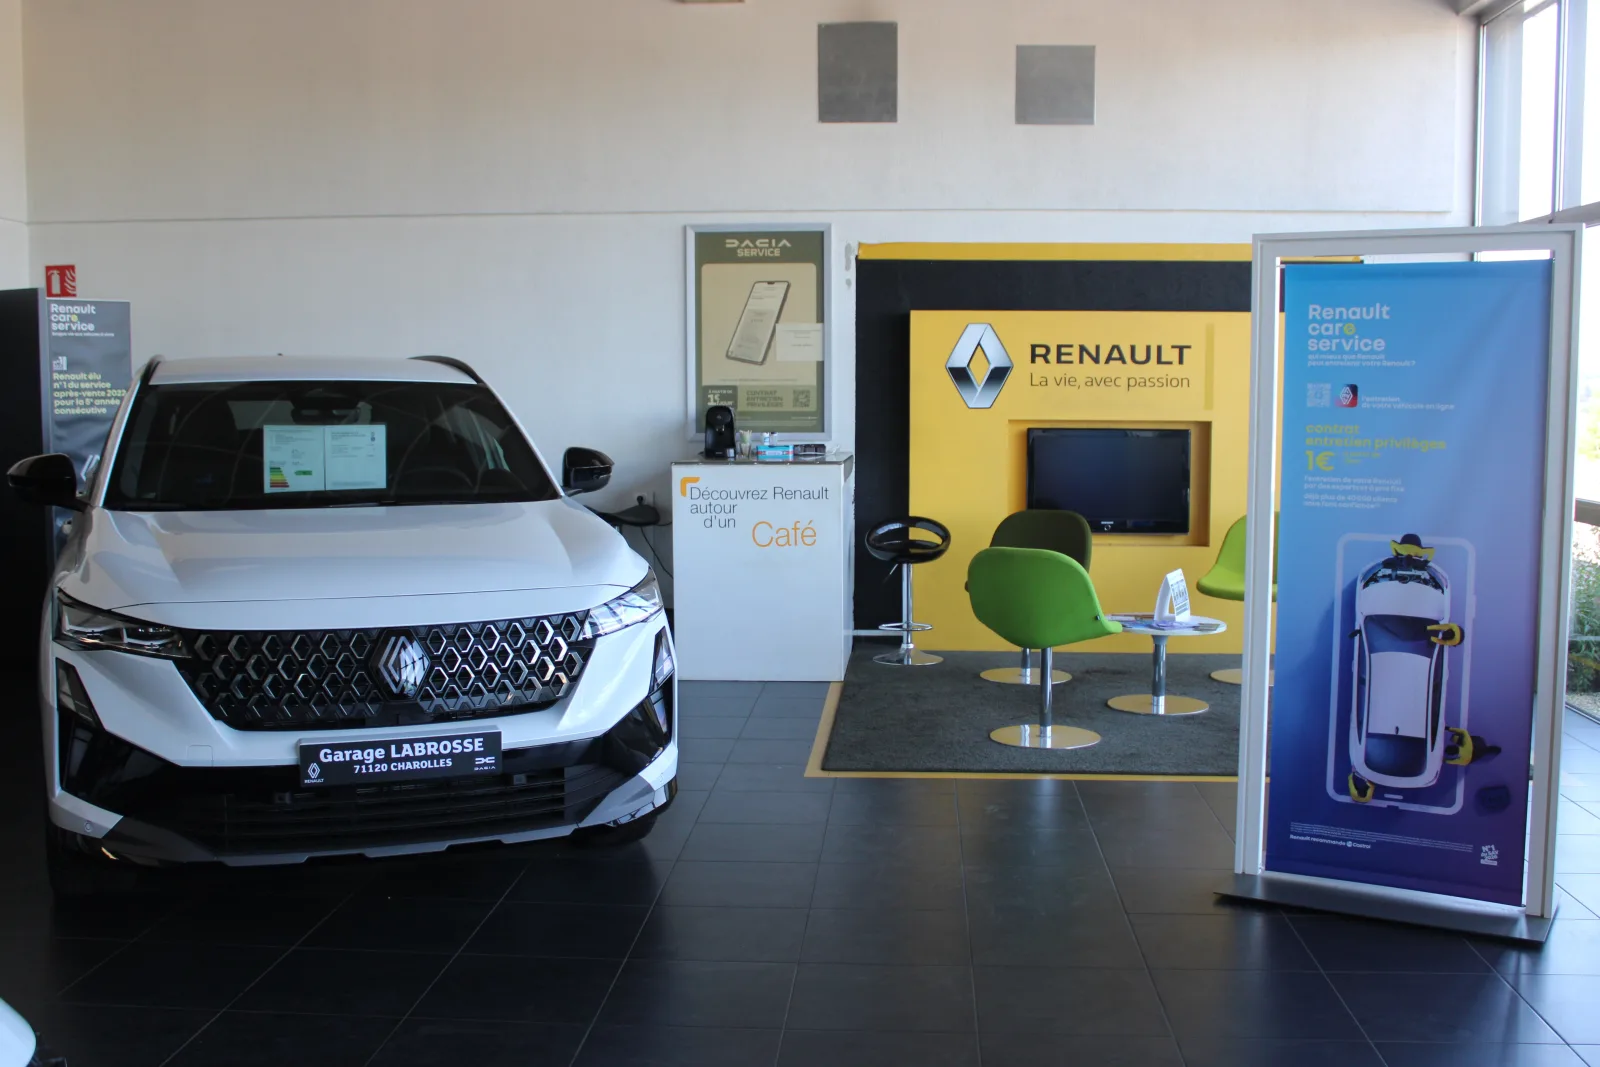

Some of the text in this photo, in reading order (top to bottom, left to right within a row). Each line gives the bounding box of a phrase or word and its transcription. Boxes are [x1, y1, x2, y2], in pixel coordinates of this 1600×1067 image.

[725, 238, 792, 247] DACIA
[737, 248, 780, 257] SERVICE
[50, 304, 96, 314] Renault
[1308, 303, 1390, 320] Renault
[51, 314, 78, 322] care
[51, 321, 95, 331] service
[1308, 322, 1356, 336] care
[1308, 336, 1386, 351] service
[1030, 344, 1192, 365] RENAULT
[53, 372, 87, 380] Renault
[1030, 372, 1191, 391] La vie, avec passion
[53, 389, 105, 398] après-vente
[54, 399, 75, 408] pour
[94, 397, 120, 405] année
[54, 407, 107, 415] consécutive
[1306, 424, 1360, 435] contrat
[1306, 436, 1446, 452] entretien privilèges
[1305, 450, 1335, 471] 1€
[690, 486, 829, 501] Découvrez Renault
[690, 502, 738, 514] autour
[704, 516, 736, 529] d'un
[752, 520, 817, 548] Café
[319, 738, 484, 763] Garage LABROSSE
[354, 758, 453, 774] 71120 CHAROLLES
